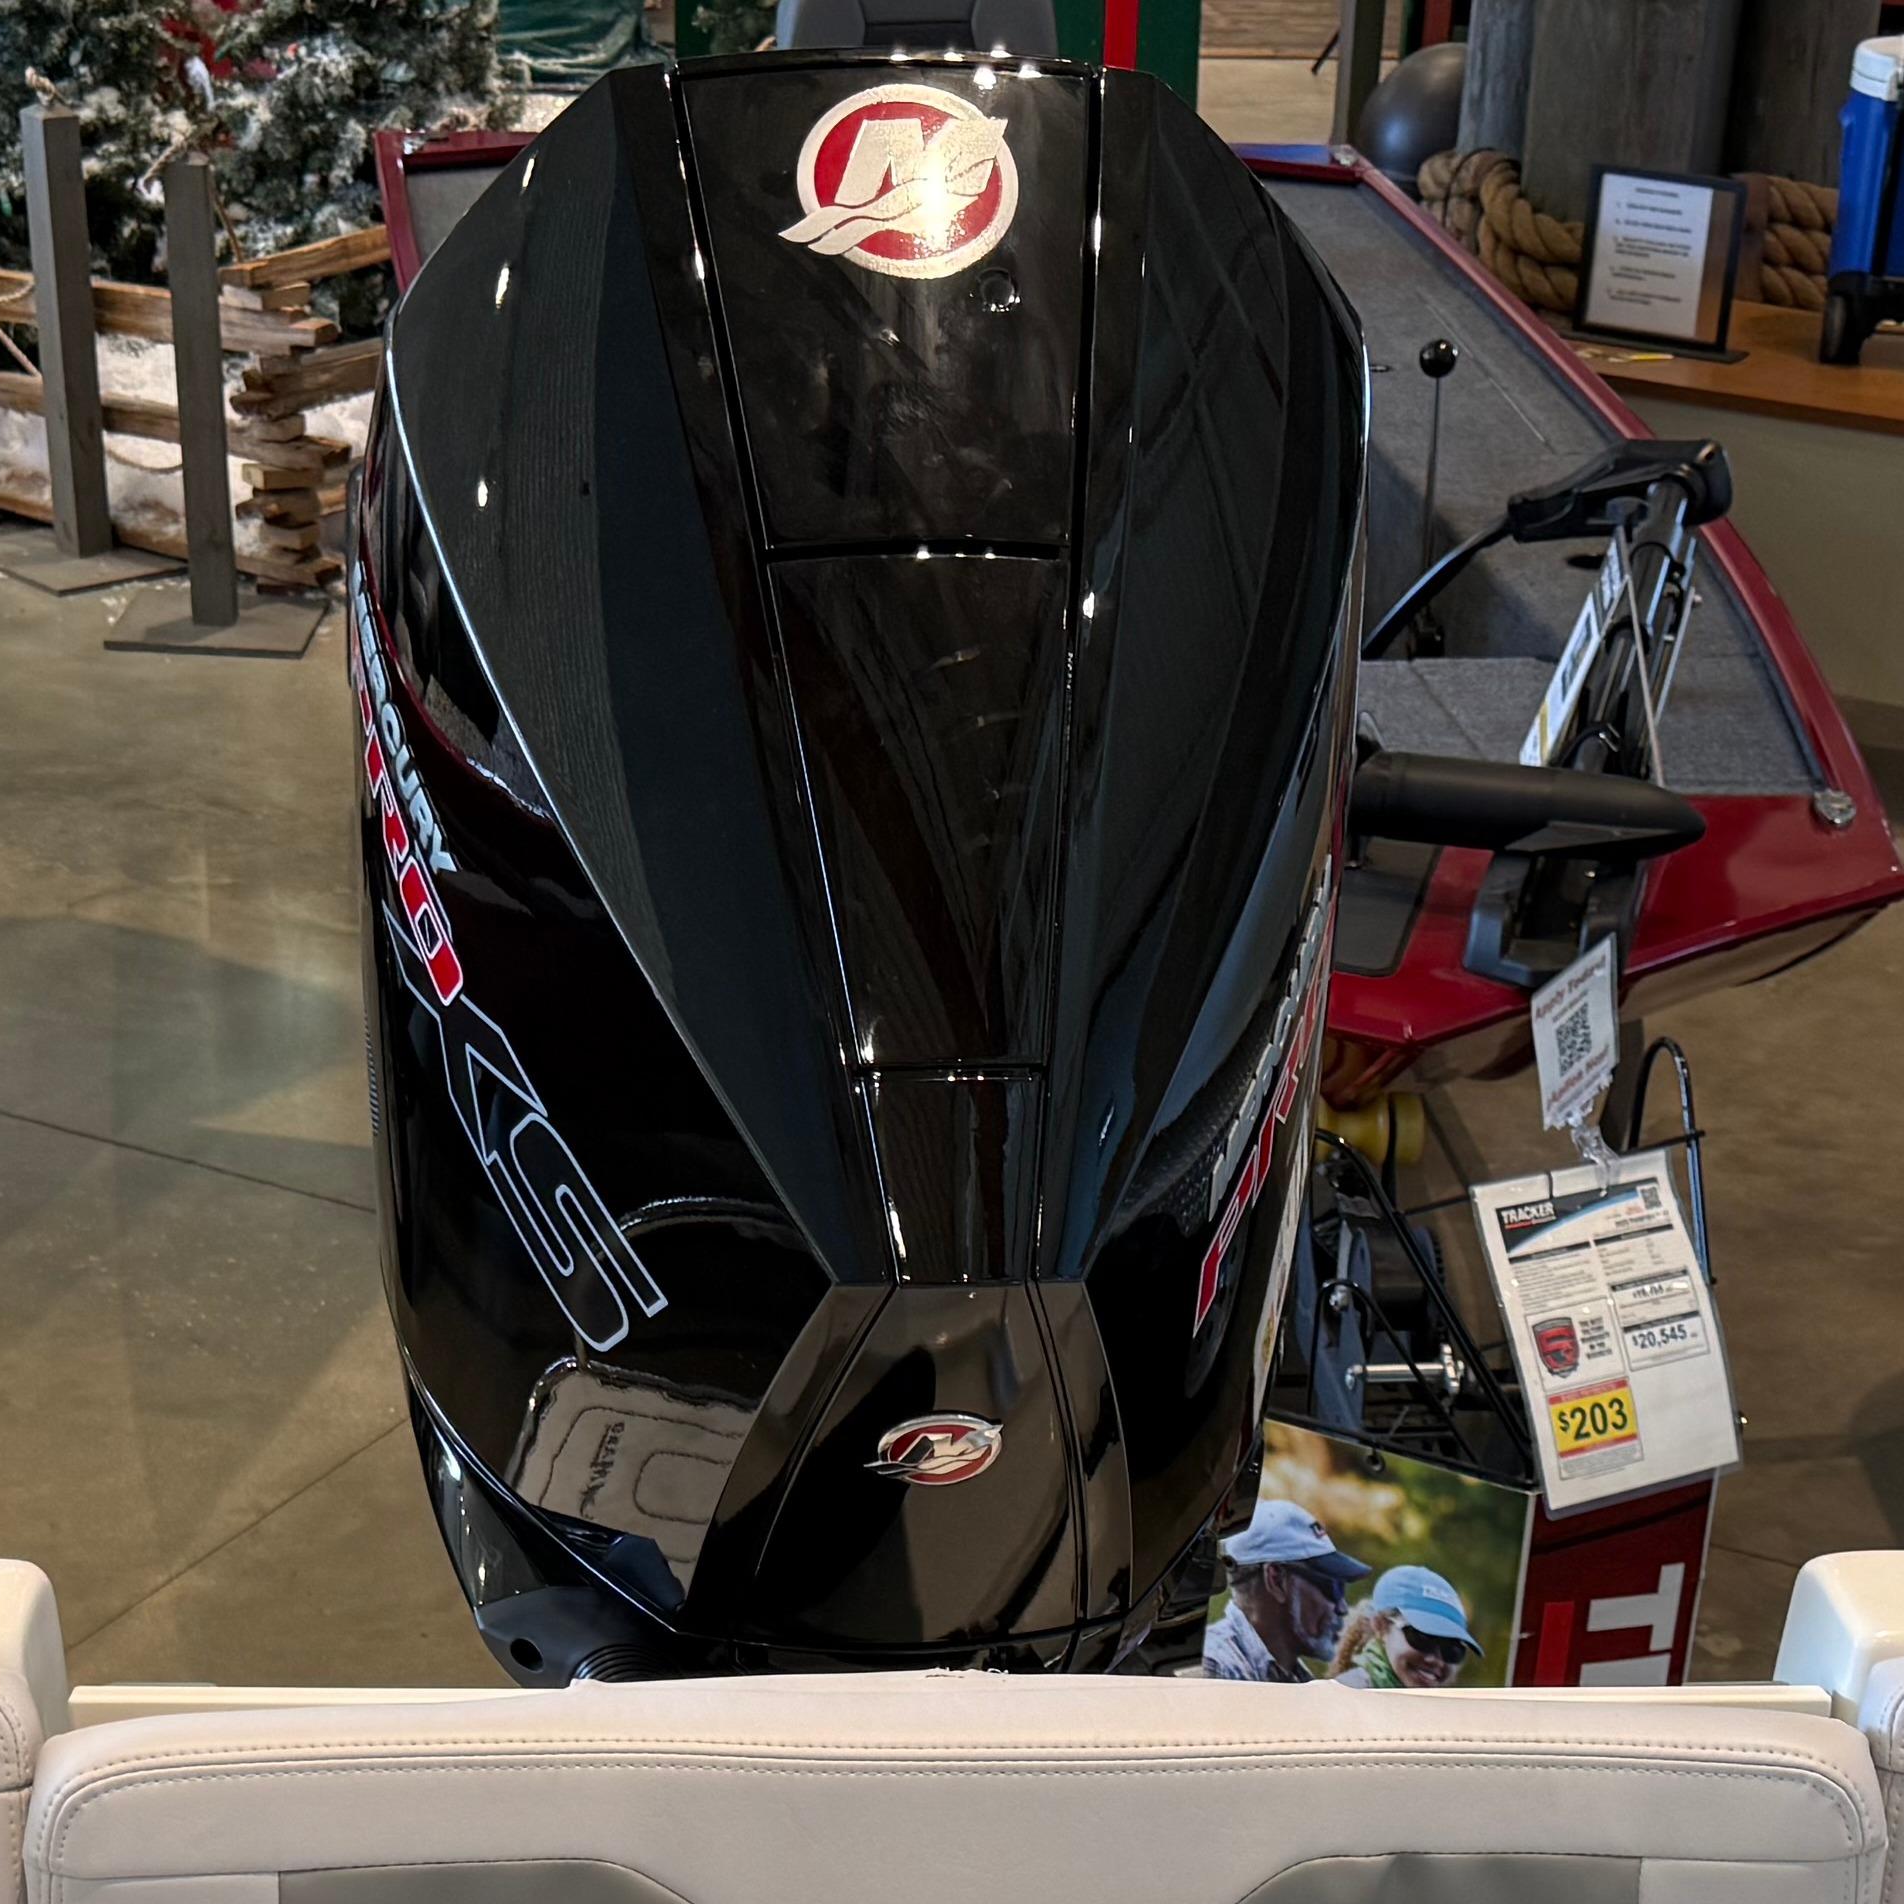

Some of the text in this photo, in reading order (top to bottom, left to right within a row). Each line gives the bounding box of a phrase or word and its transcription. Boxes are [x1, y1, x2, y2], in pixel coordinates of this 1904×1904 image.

[1500, 1200, 1555, 1226] TRACKER
[1632, 1323, 1688, 1350] $20,545
[1558, 1397, 1628, 1441] $203
